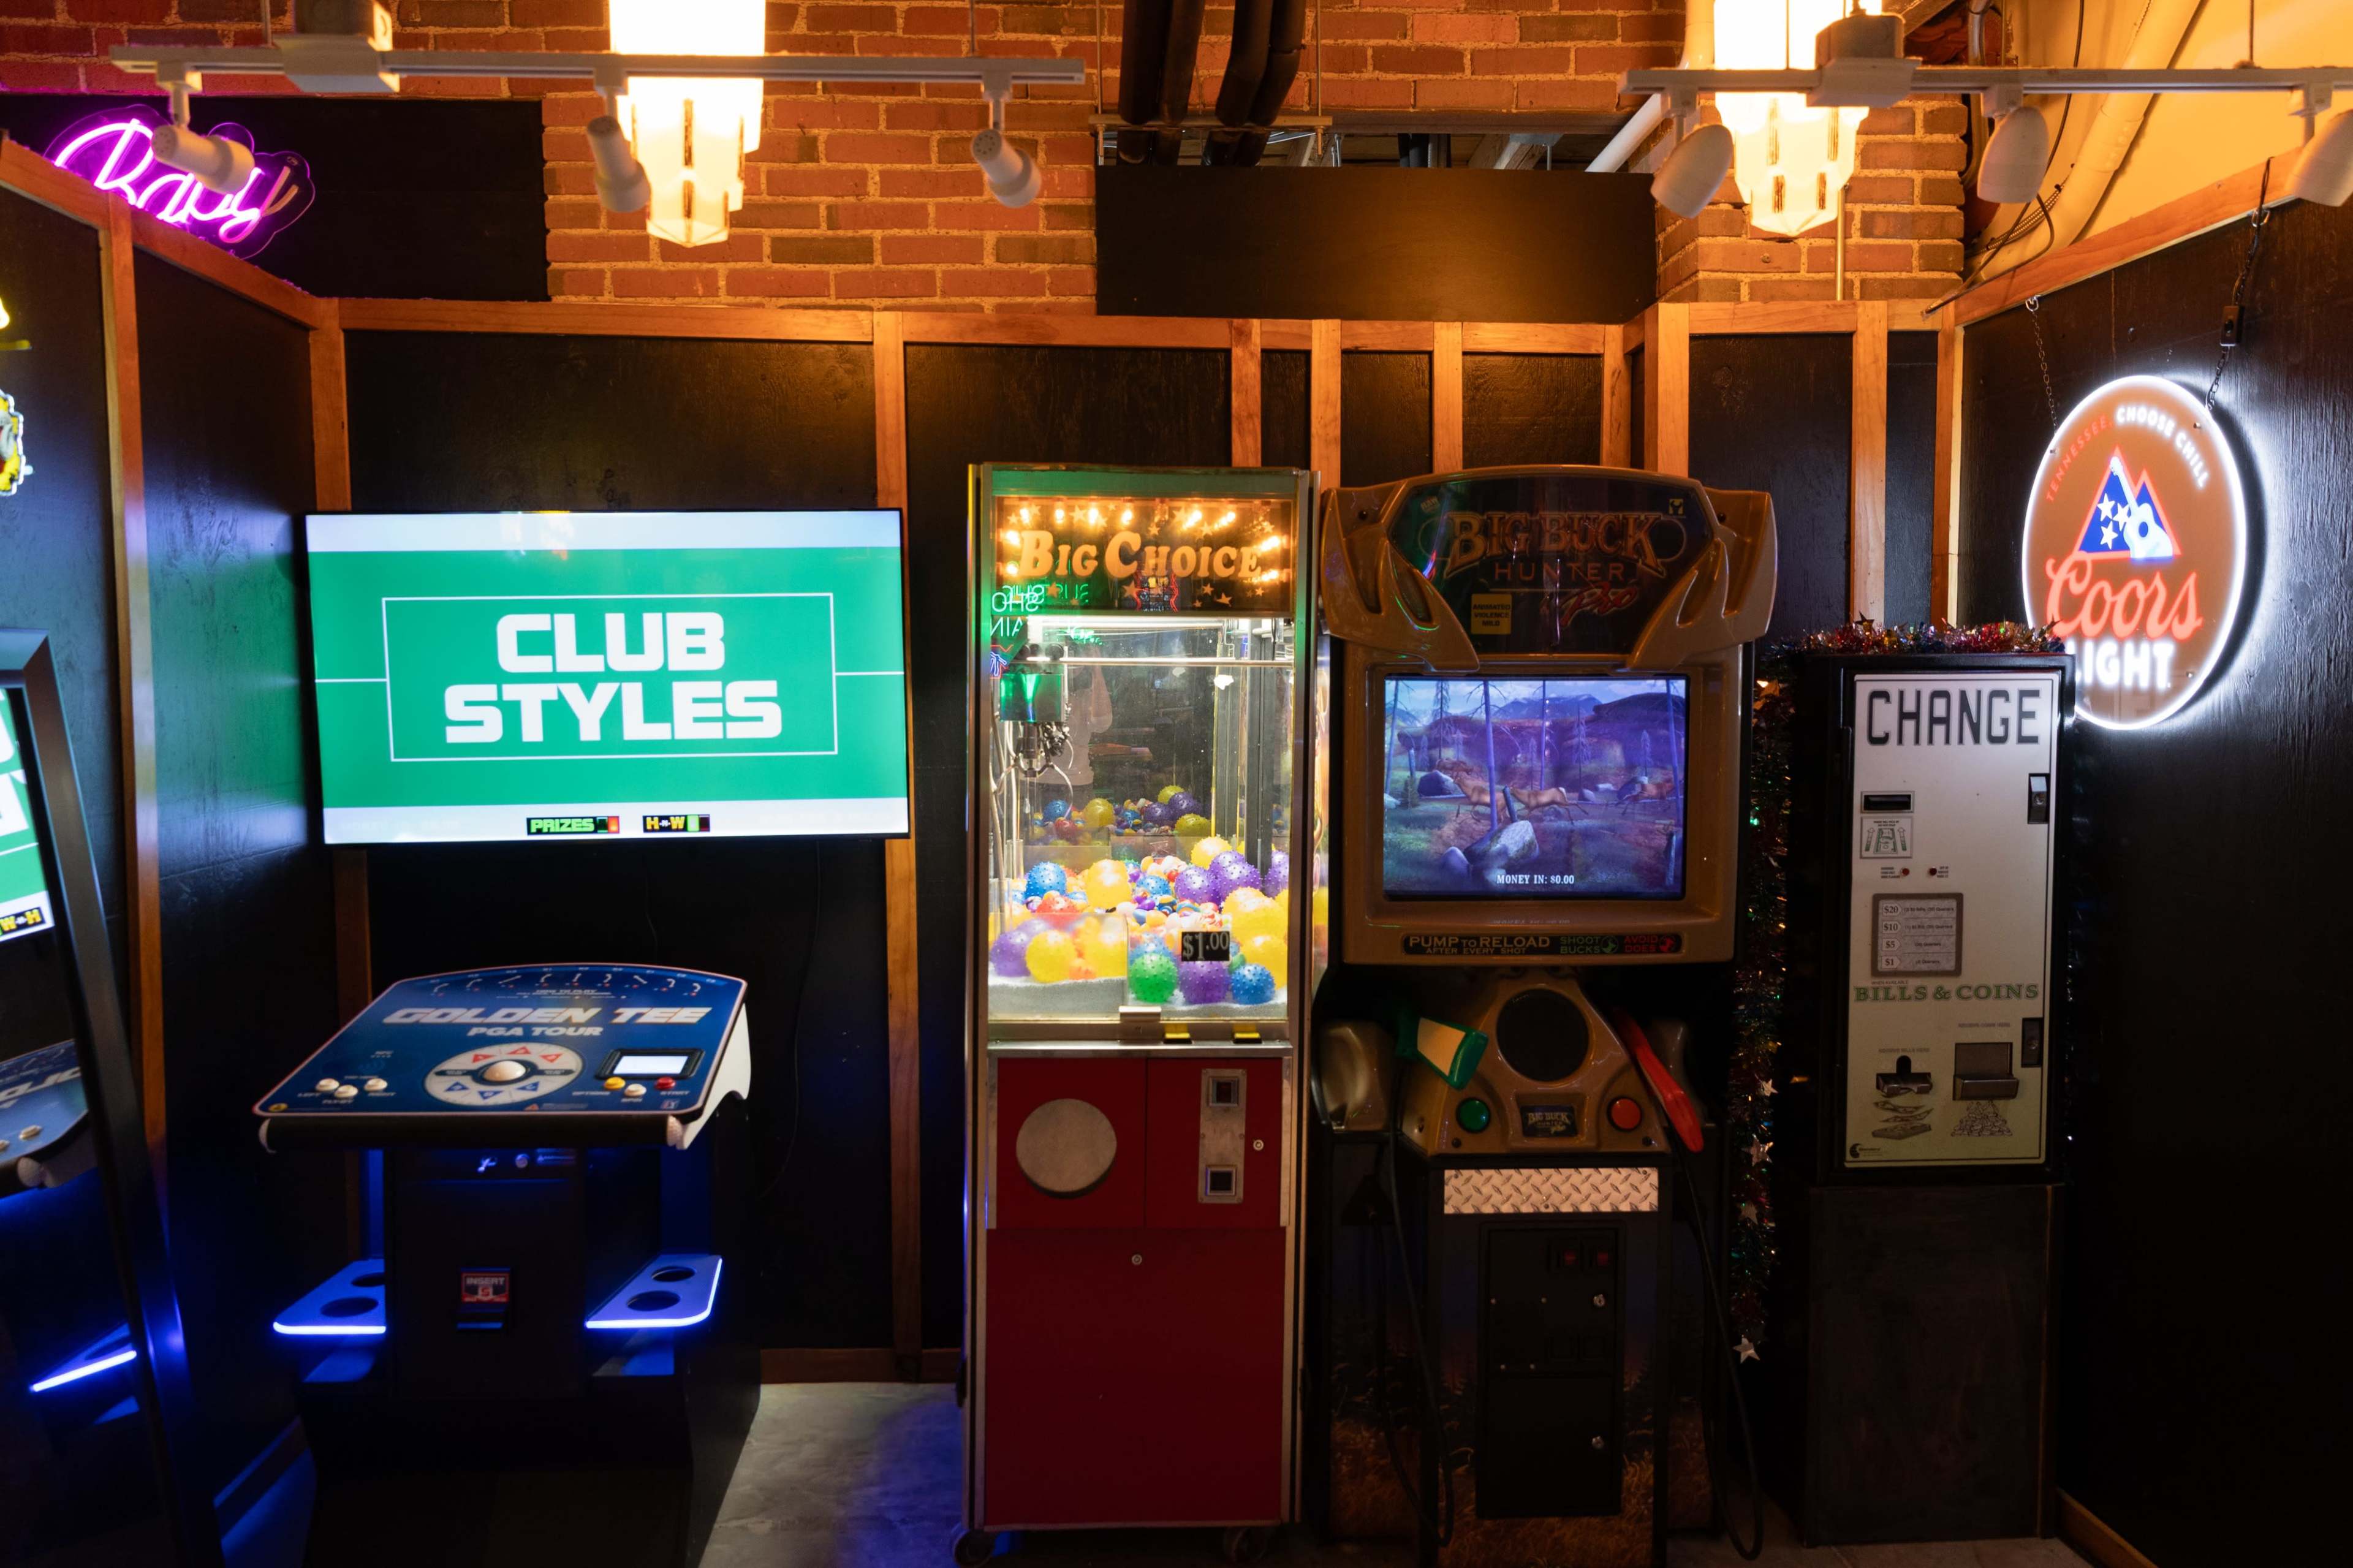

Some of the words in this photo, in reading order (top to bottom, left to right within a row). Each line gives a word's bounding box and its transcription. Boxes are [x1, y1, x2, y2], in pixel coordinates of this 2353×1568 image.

[2116, 405, 2175, 439] CHOOSE
[2174, 431, 2211, 490] CHILL
[1445, 511, 1529, 579] BIG
[1539, 511, 1666, 579] BUCK
[1495, 563, 1625, 581] HUNTER
[1560, 581, 1638, 628] Pro
[2045, 551, 2203, 642] Coors
[496, 612, 725, 674] CLUB
[2065, 639, 2175, 689] LIGHT
[444, 680, 782, 743] STYLES
[1867, 688, 2040, 746] CHANGE
[530, 818, 594, 833] PRIZES
[1497, 874, 1530, 884] MONEY
[1533, 874, 1548, 884] IN:
[1550, 874, 1575, 884] $0.00
[1183, 931, 1229, 962] $1.00
[1409, 936, 1459, 949] PUMP
[1479, 936, 1550, 949] RELOAD
[1560, 936, 1601, 945] SHOOT
[1624, 936, 1659, 944] AVOID
[1560, 945, 1601, 954] BUCKS
[1854, 986, 1928, 1002] BILLS
[1933, 986, 1951, 1001] &
[1956, 984, 2039, 1000] COINS
[383, 1007, 602, 1025] GOLDEN
[611, 1007, 713, 1025] TEE
[468, 1027, 525, 1036] PGA
[531, 1026, 602, 1036] TOUR
[1528, 1112, 1543, 1124] BIG
[1544, 1112, 1571, 1125] BUCK
[466, 1276, 506, 1285] INSERT
